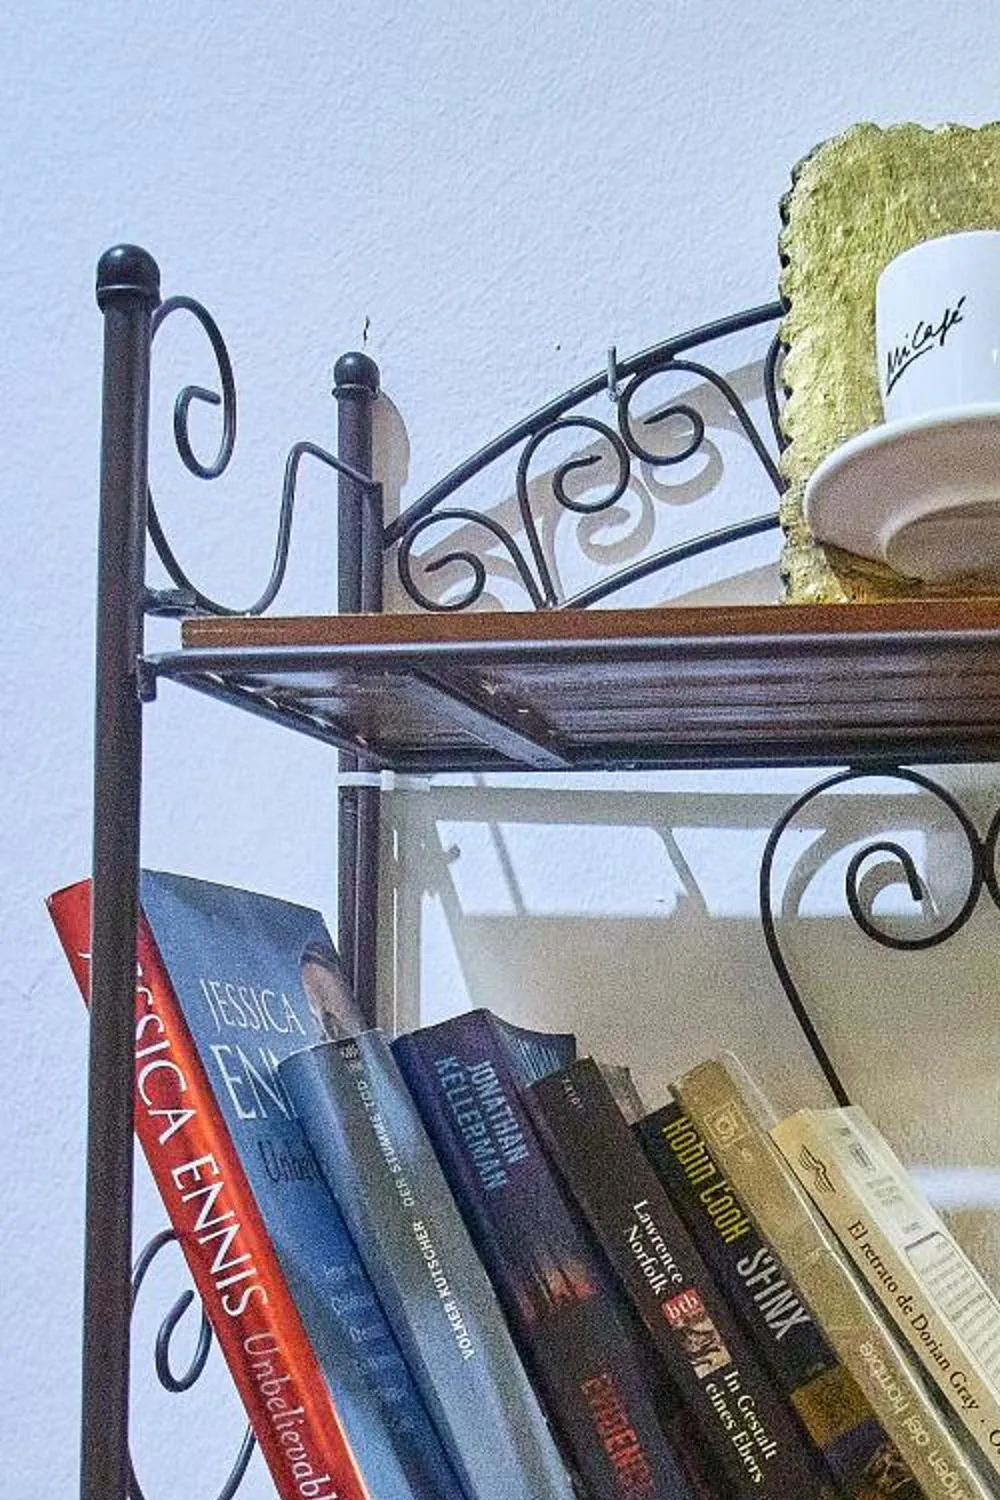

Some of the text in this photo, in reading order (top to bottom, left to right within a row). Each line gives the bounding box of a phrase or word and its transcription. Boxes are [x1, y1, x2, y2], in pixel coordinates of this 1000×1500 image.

[911, 295, 967, 350] Café
[199, 979, 306, 1035] JESSICA
[370, 1114, 402, 1174] STUMME
[434, 1055, 509, 1192] KELLERMAN
[467, 1060, 530, 1163] JONATHAN
[170, 1152, 269, 1318] ENNIS
[412, 1219, 451, 1302] KUTSCHER
[627, 1224, 669, 1296] Norfolk
[633, 1199, 684, 1285] Lawrence
[444, 1300, 475, 1361] VOLKER
[665, 1292, 700, 1320] btb
[736, 1247, 812, 1341] SFINX
[848, 1219, 868, 1240] El
[860, 1241, 898, 1293] retrato
[896, 1292, 913, 1317] de
[910, 1313, 950, 1372] Dorian
[949, 1370, 980, 1413] Gray
[705, 1381, 764, 1484] eines Ebers
[723, 1370, 778, 1459] In Gestalt
